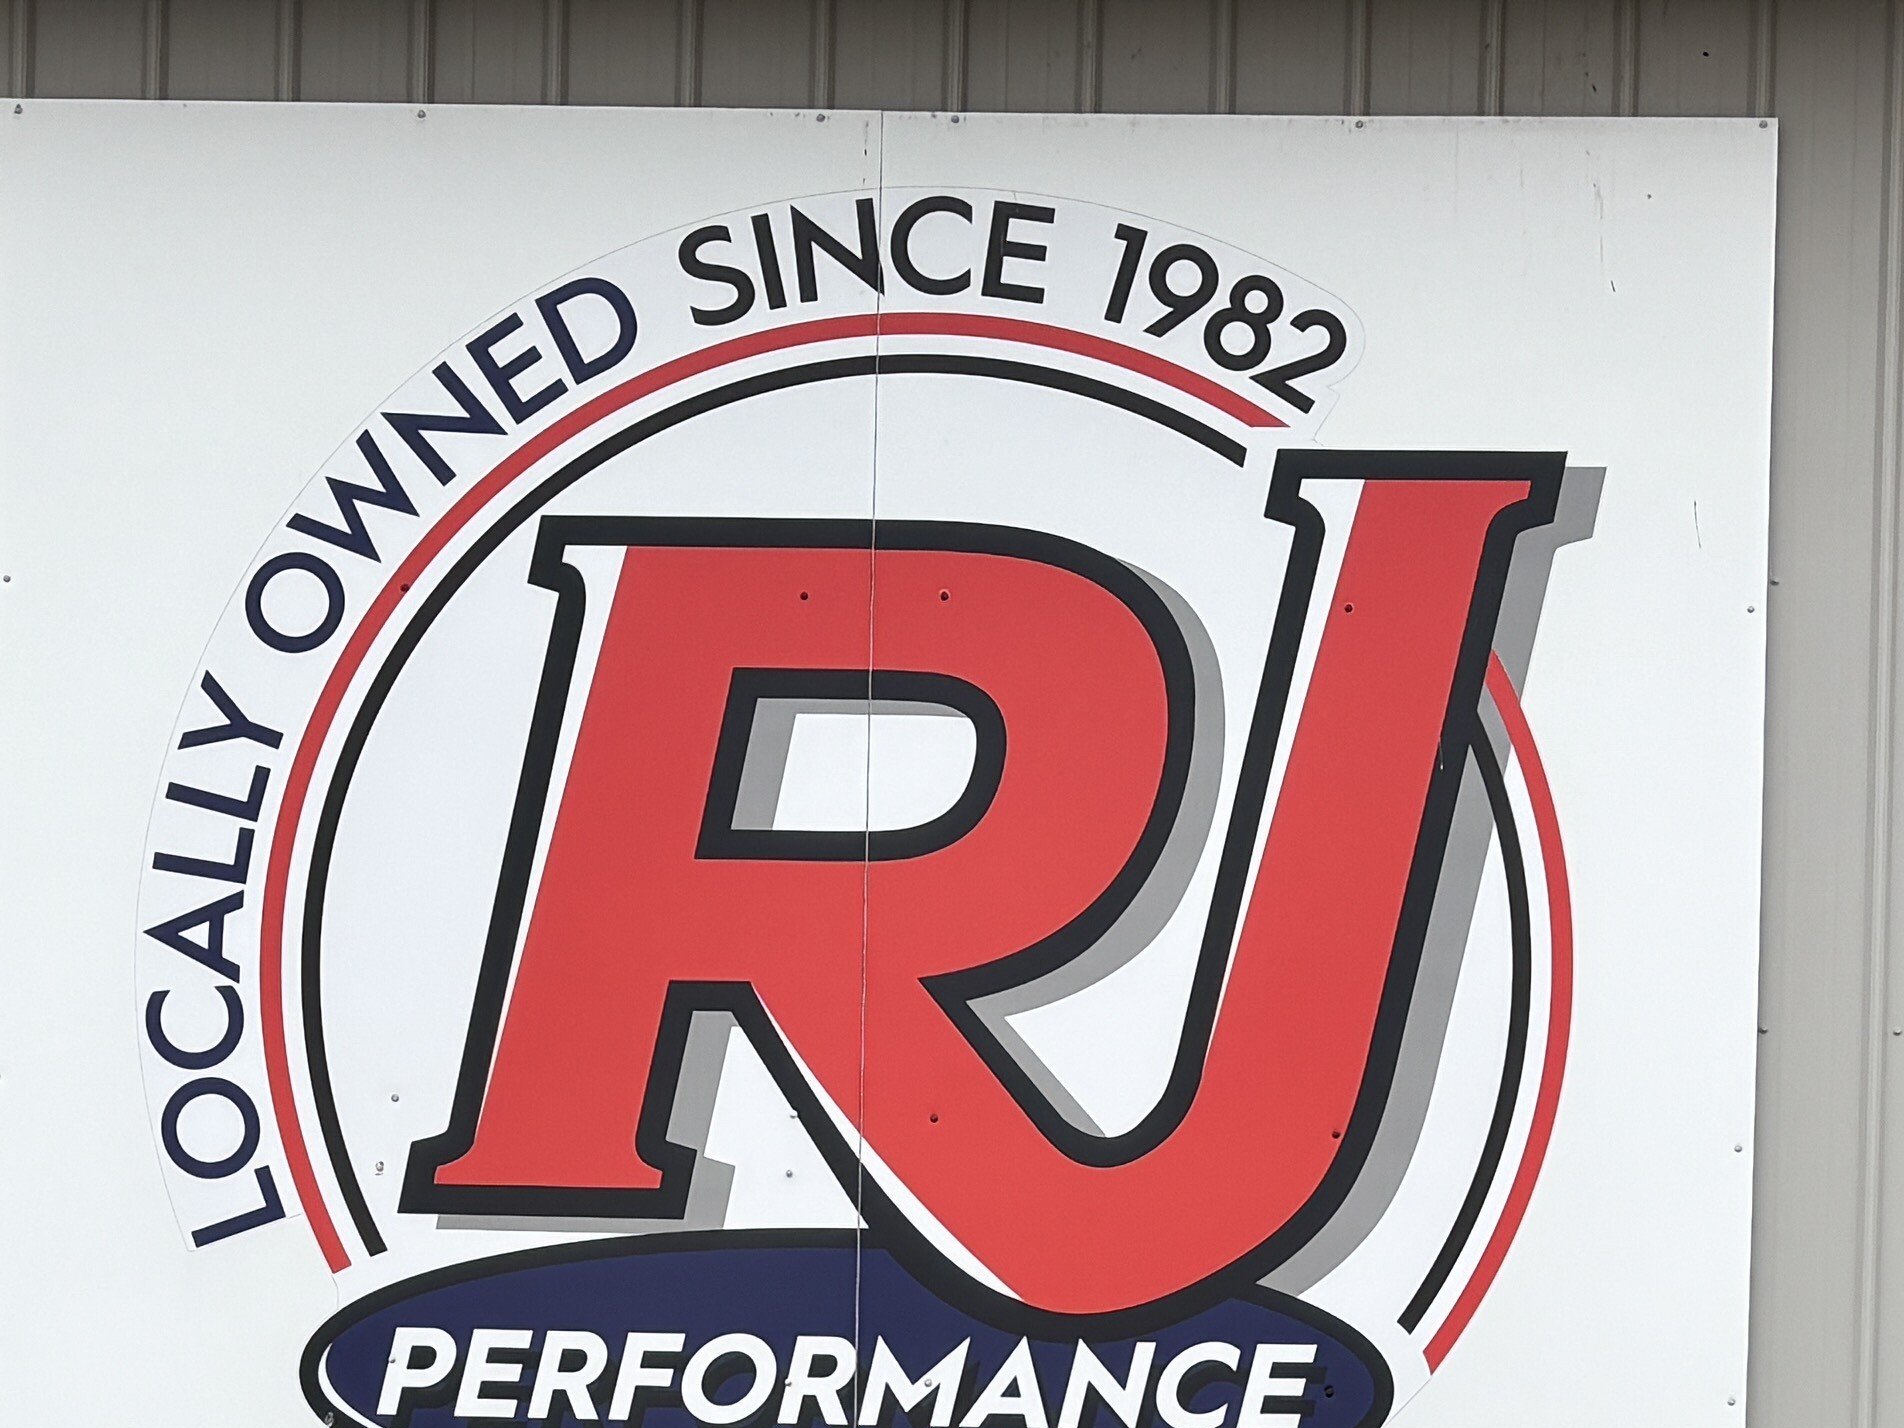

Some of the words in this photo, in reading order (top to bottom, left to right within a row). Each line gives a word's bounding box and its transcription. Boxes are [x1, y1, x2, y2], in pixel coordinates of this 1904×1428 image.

[143, 669, 286, 1247] LOCALLY
[245, 277, 638, 654] OWNED
[678, 195, 1056, 326] SINCE
[1104, 222, 1351, 415] 1982
[398, 449, 1569, 1342] RJ
